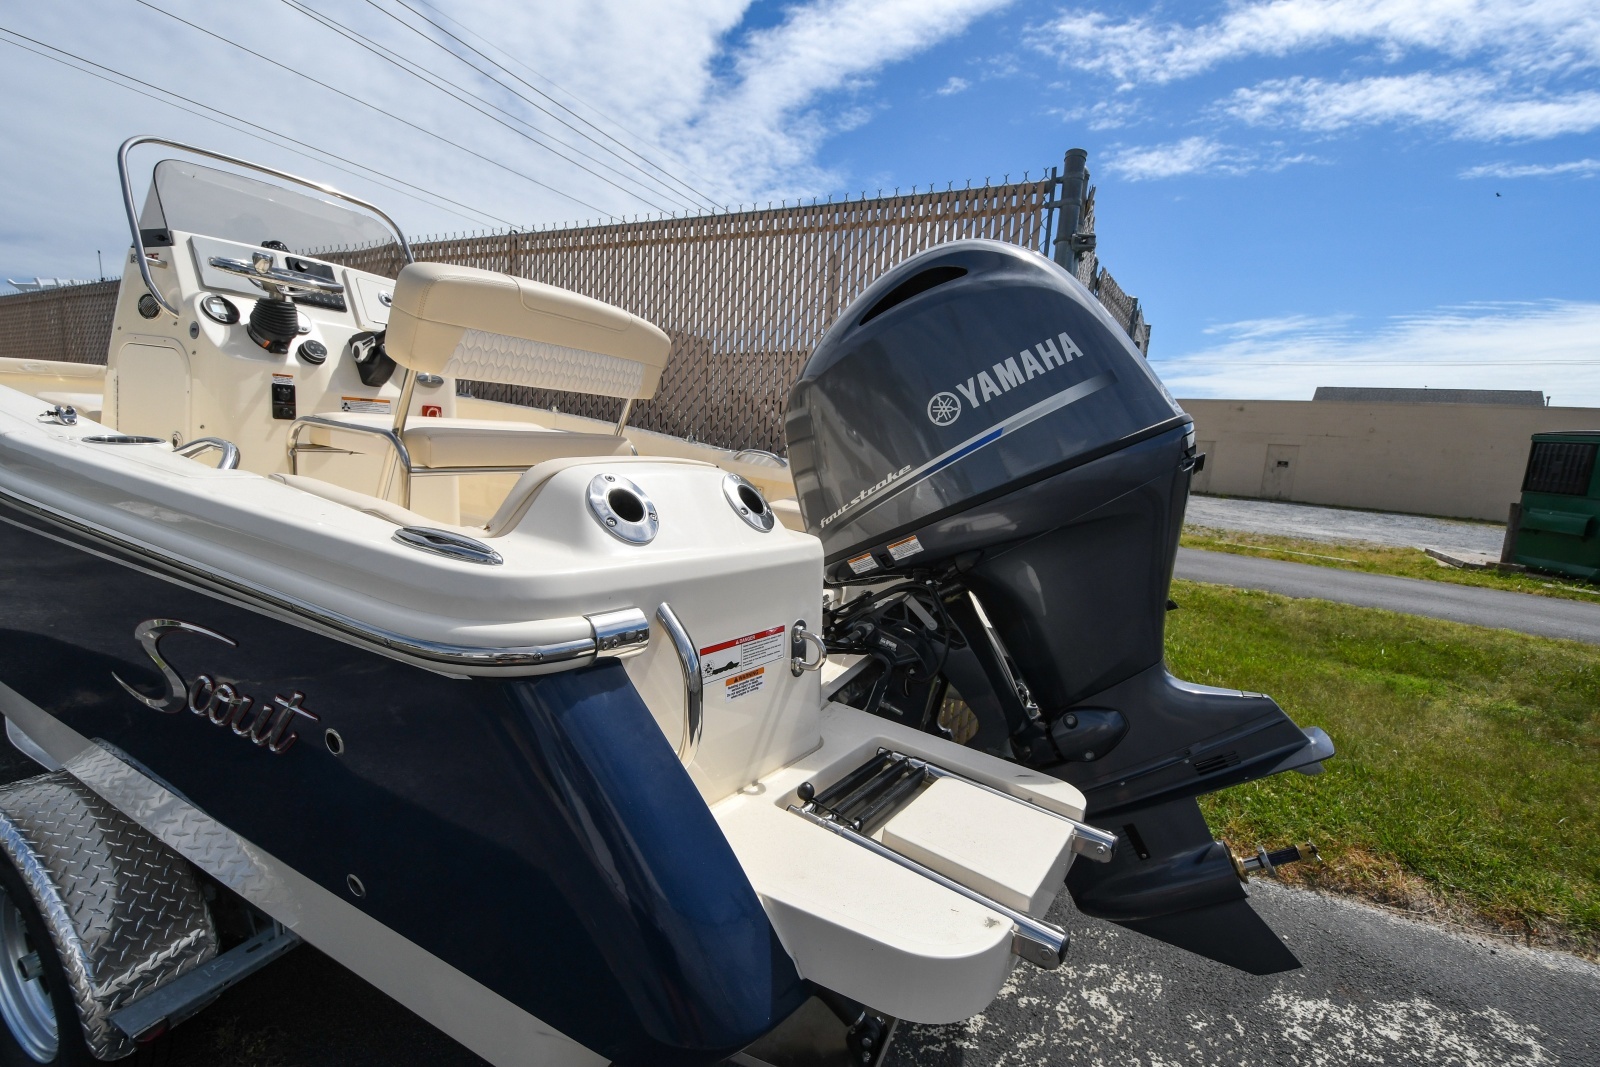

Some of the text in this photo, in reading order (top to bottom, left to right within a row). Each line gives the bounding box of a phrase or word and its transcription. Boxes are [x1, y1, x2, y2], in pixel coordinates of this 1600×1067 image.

[955, 331, 1084, 409] YAMAHA
[740, 635, 756, 644] DANGER
[111, 618, 321, 754] Scout
